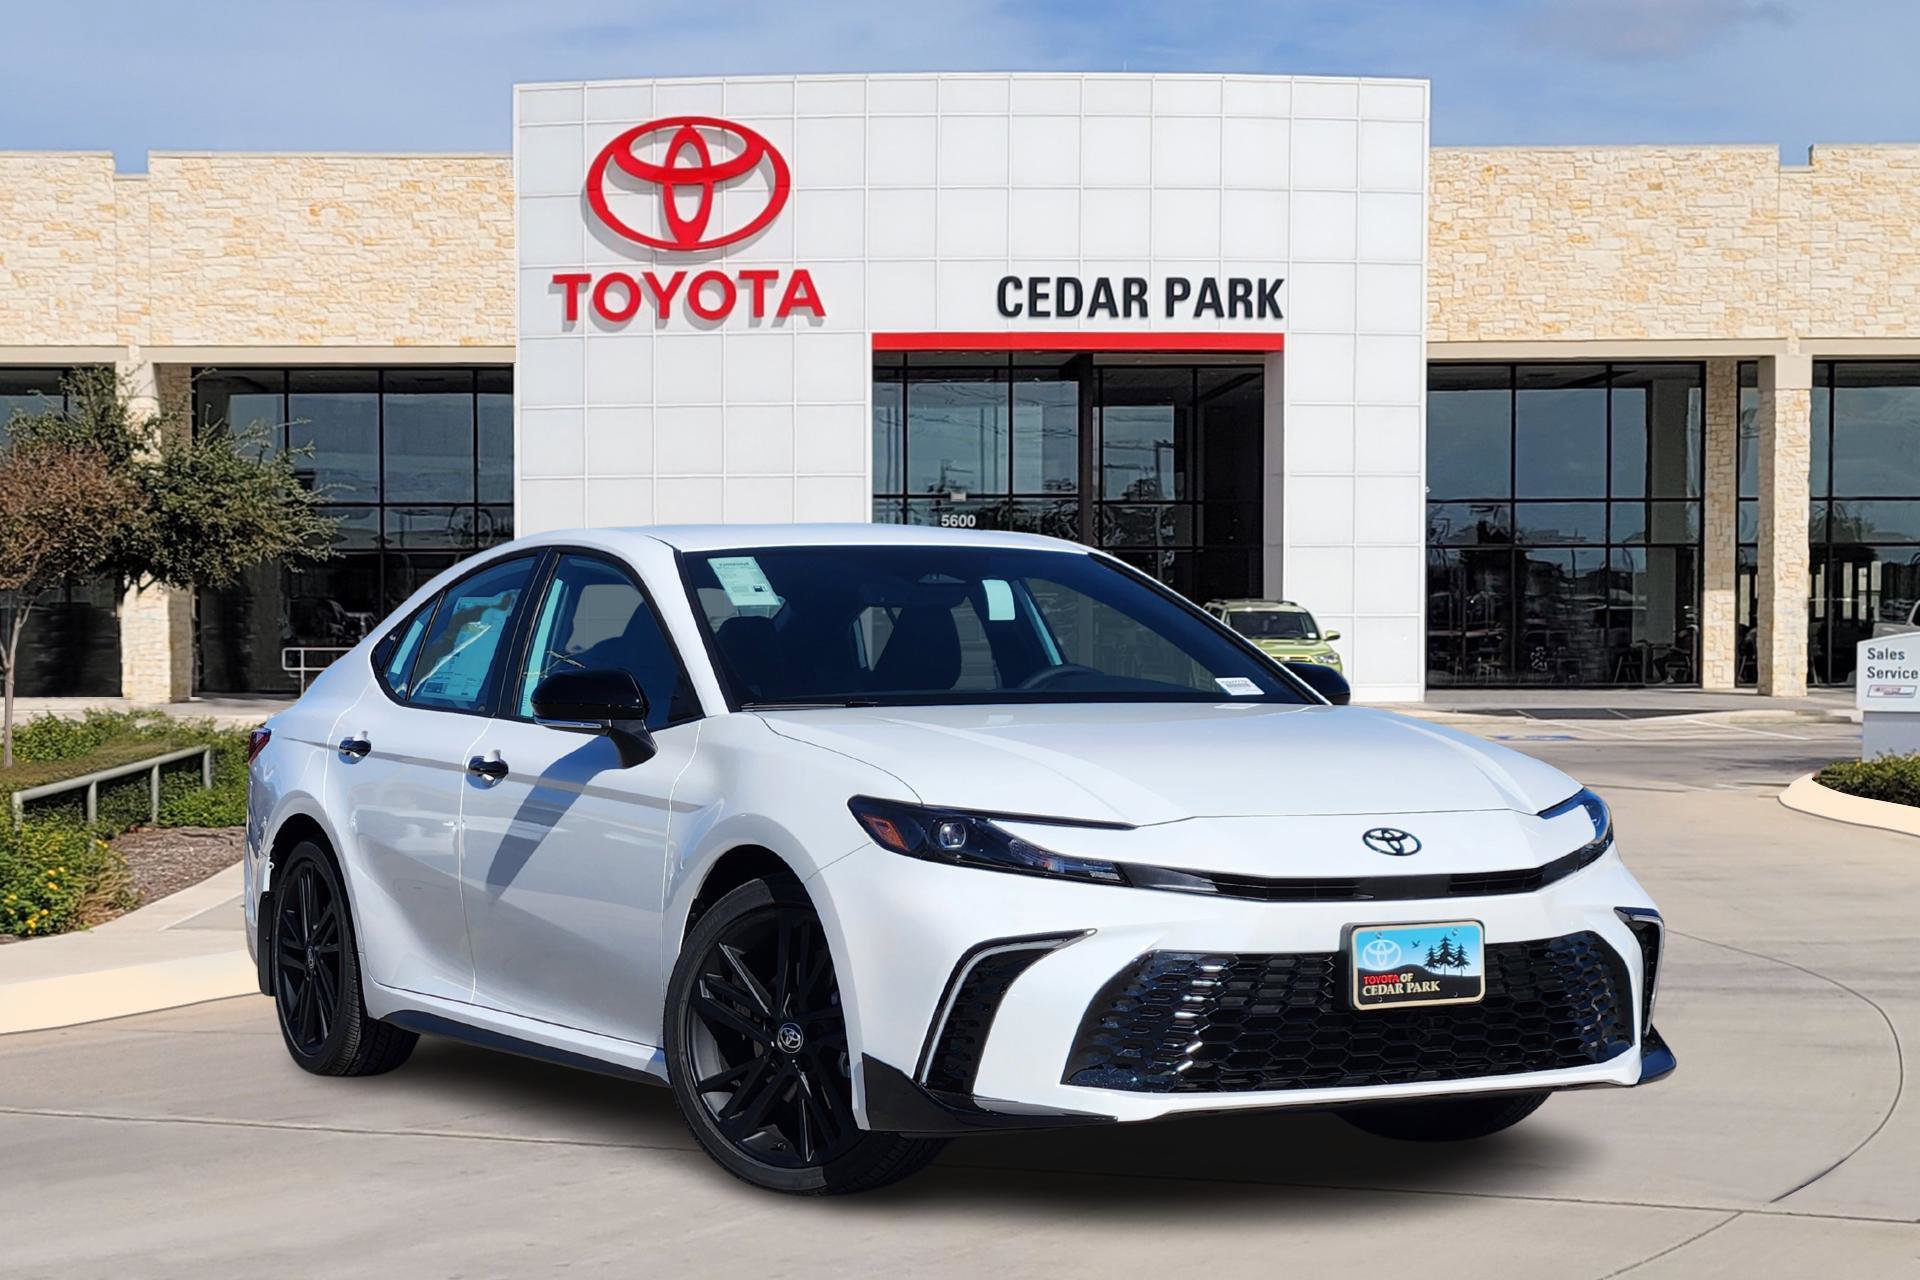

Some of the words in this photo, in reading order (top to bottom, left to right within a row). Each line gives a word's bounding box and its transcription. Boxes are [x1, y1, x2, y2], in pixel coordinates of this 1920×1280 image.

[552, 269, 827, 323] TOYOTA
[997, 275, 1149, 318] CEDAR
[1164, 276, 1285, 320] PARK
[941, 514, 976, 527] 5600
[1867, 647, 1905, 660] Sales
[1867, 666, 1919, 679] Service
[1363, 974, 1399, 985] TOYOTA
[1400, 973, 1414, 983] OF
[1362, 983, 1403, 996] CEDAR
[1406, 981, 1440, 993] PARK
